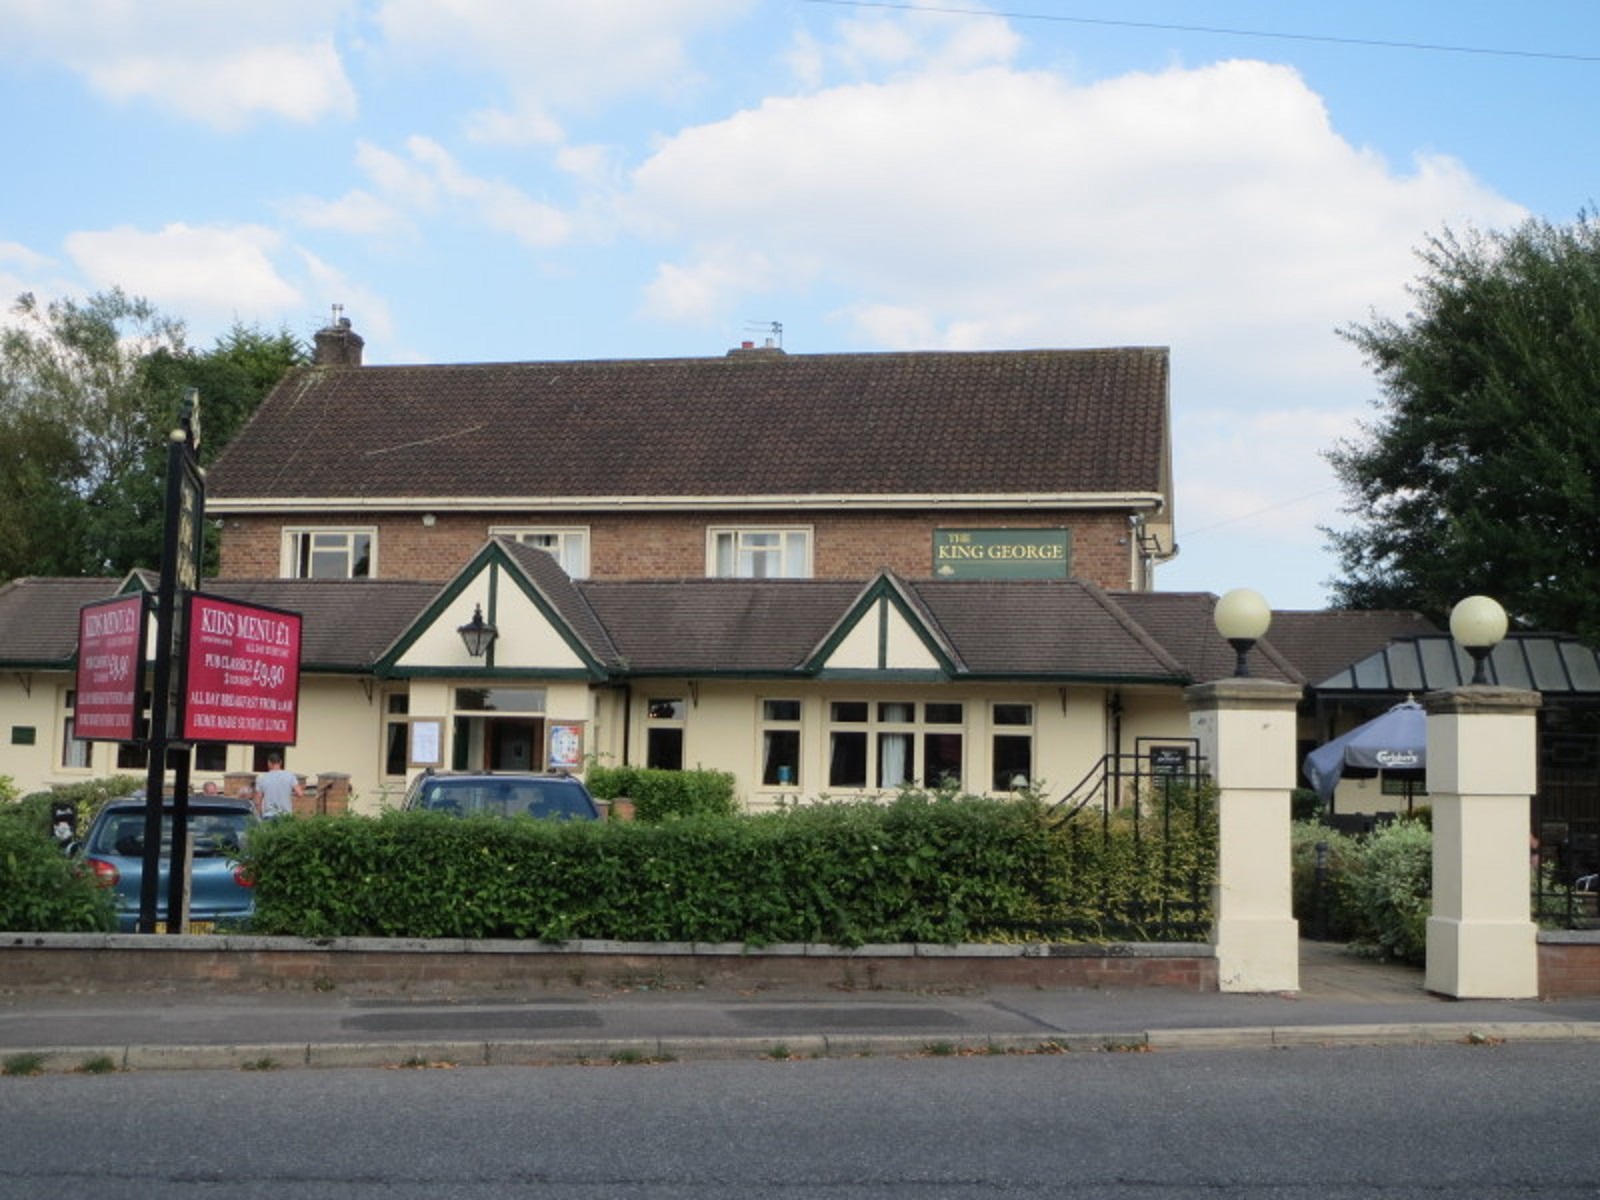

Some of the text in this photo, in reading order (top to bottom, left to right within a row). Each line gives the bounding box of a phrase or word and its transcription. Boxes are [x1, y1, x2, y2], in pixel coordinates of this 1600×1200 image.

[939, 545, 1063, 559] KING GEORGE
[202, 607, 290, 646] KIDS MENU £1
